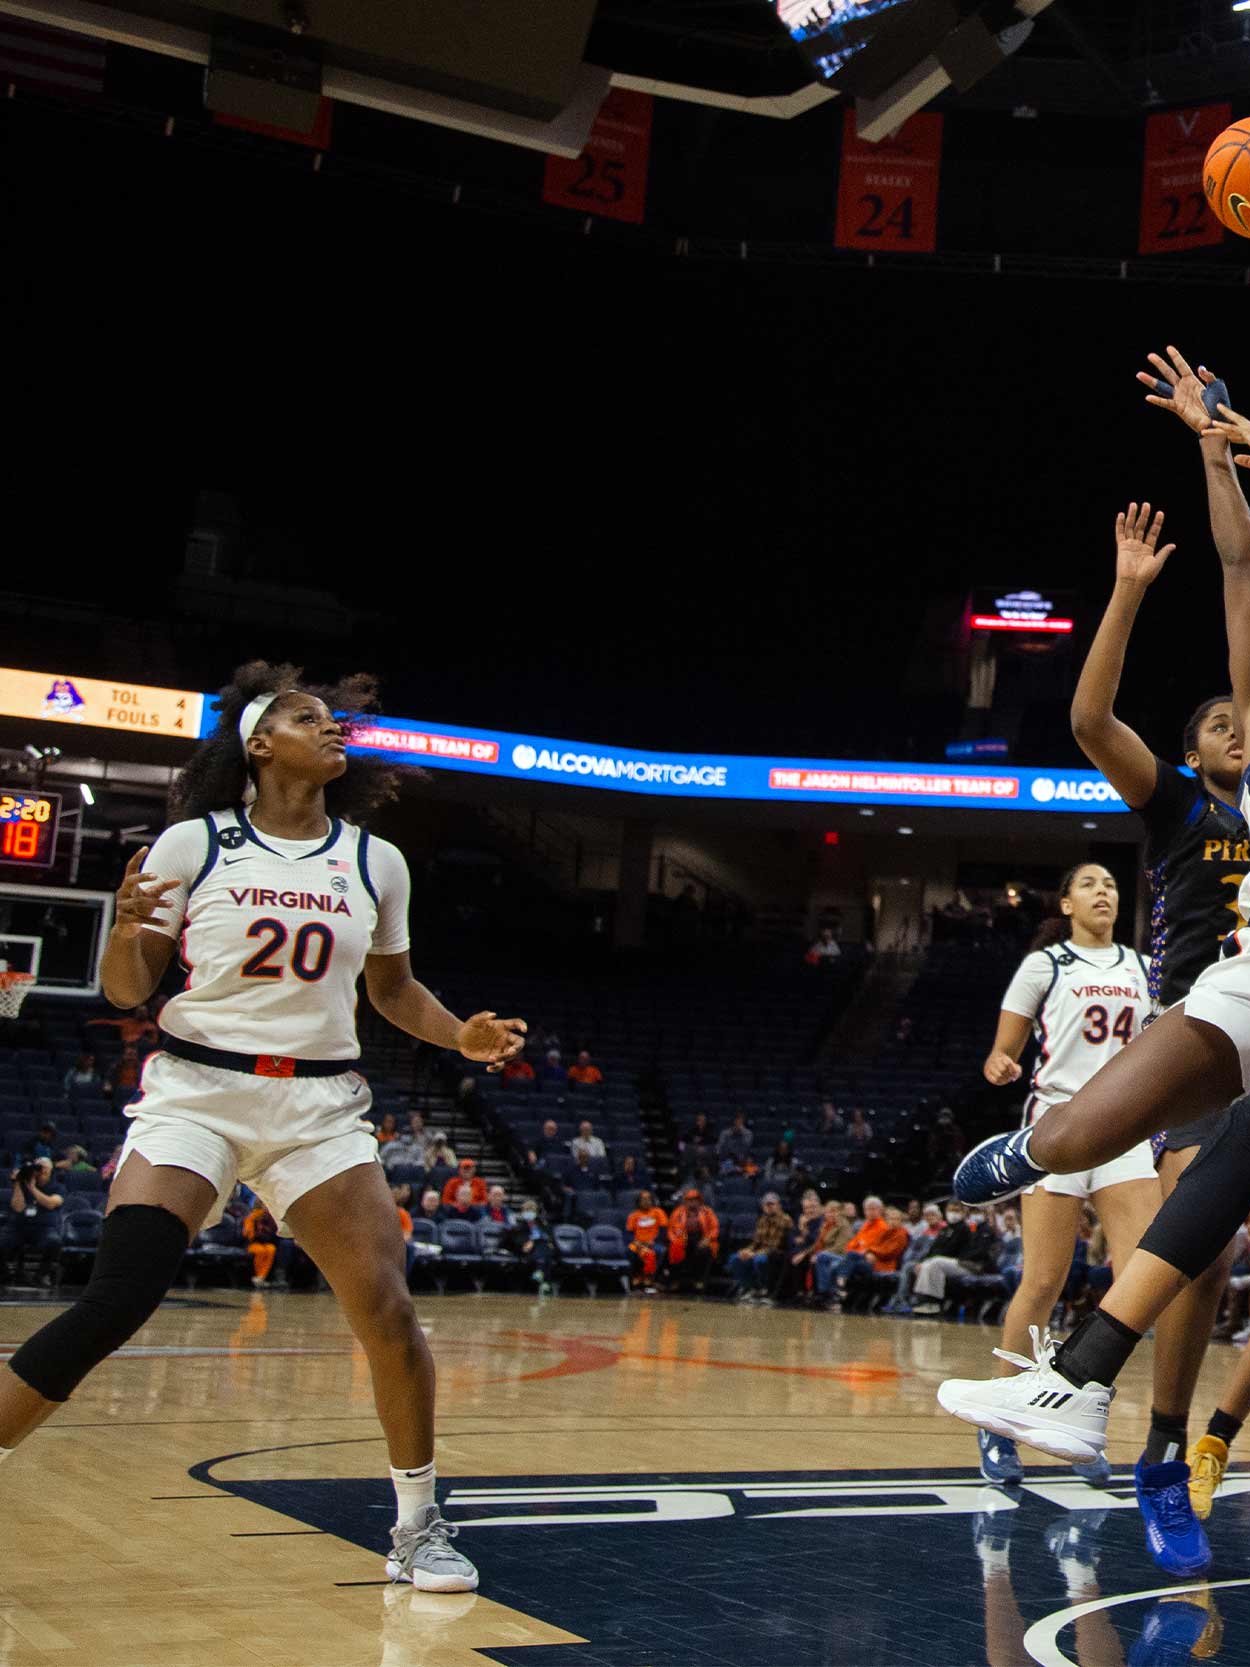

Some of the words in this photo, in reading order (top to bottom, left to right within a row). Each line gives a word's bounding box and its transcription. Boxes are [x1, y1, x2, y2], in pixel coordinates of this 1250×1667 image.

[565, 153, 625, 203] 25
[857, 194, 913, 239] 24
[1157, 192, 1207, 238] 22
[112, 689, 140, 706] TOL
[176, 698, 187, 711] 4
[107, 708, 160, 728] FOULS
[174, 717, 184, 730] 4
[429, 737, 470, 757] TEAM
[471, 743, 494, 759] OF
[774, 773, 800, 786] THE
[802, 774, 850, 789] JASON
[953, 779, 991, 796] TEAM
[993, 781, 1015, 796] OF
[0, 797, 51, 822] 2:20
[3, 822, 40, 858] 18
[228, 888, 352, 918] VIRGINIA
[240, 917, 335, 983] 20
[1072, 985, 1142, 1002] VIRGINIA
[1083, 1004, 1134, 1046] 34
